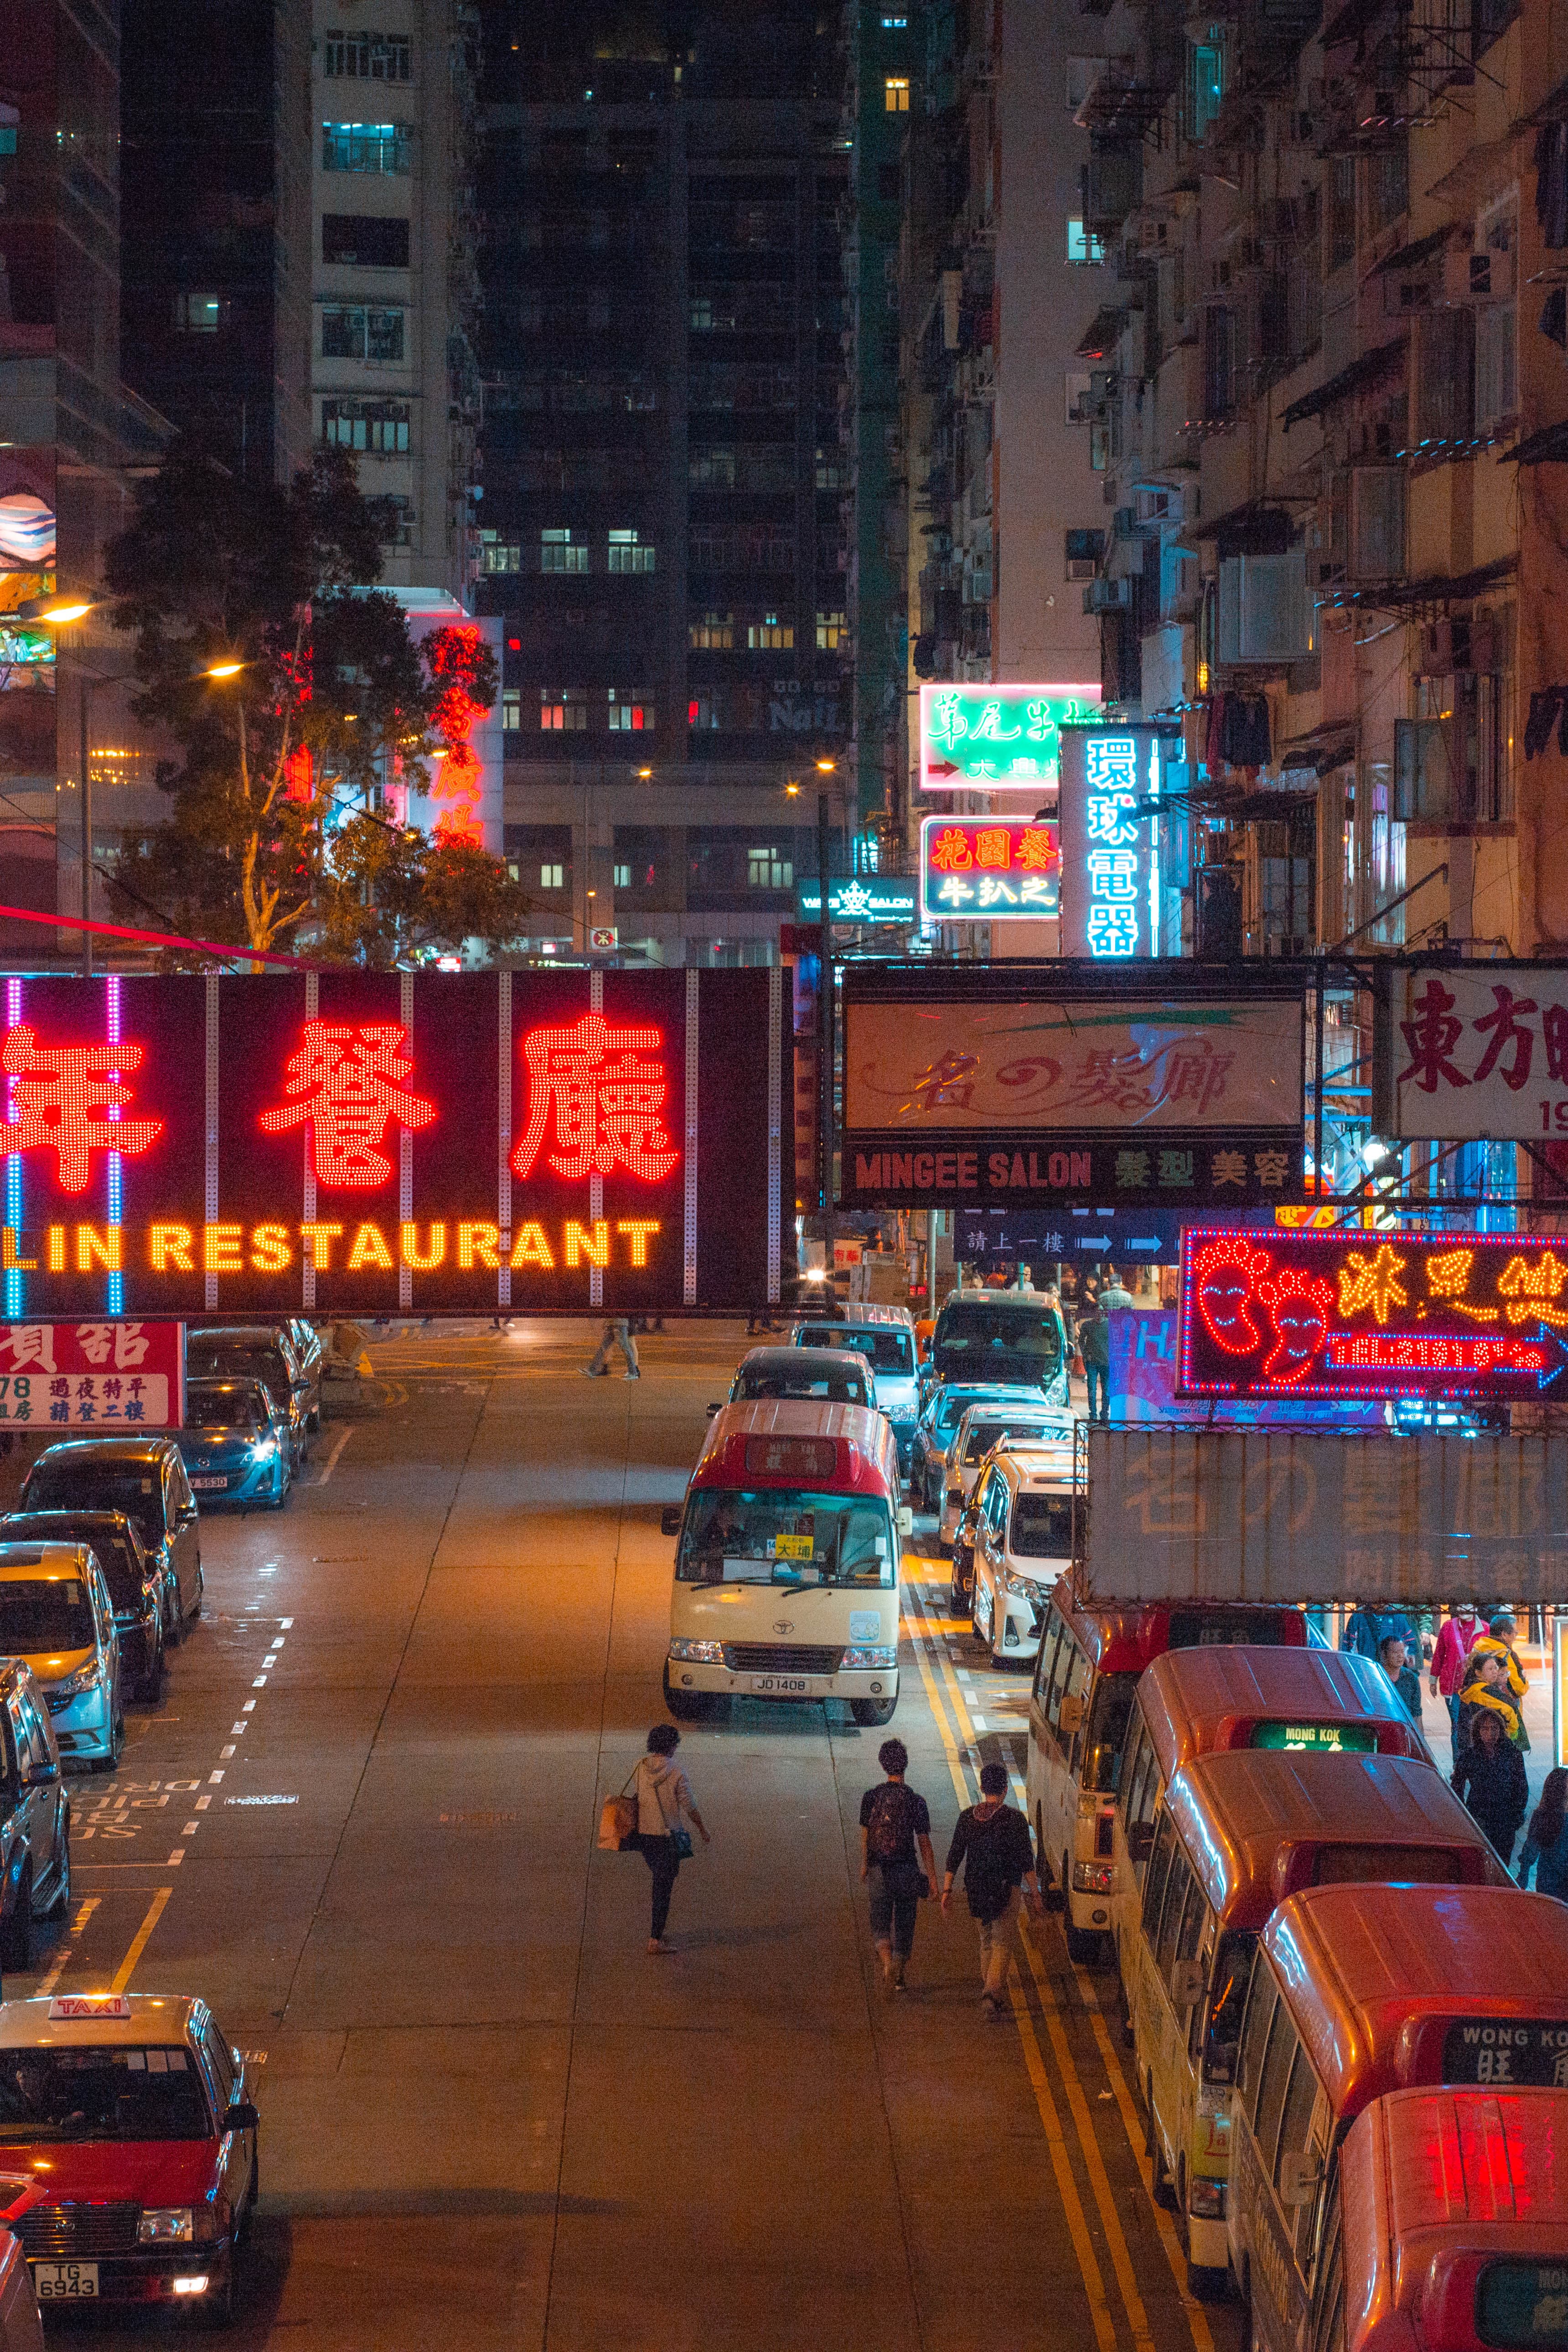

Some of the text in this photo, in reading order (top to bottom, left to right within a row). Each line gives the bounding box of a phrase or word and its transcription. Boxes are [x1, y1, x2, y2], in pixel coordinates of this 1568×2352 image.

[931, 828, 1056, 870] 花園餐
[1087, 738, 1139, 956] 環球電器
[938, 876, 1056, 907] 牛扒之
[868, 898, 913, 909] SALON
[855, 1153, 978, 1187] MINGEE
[989, 1151, 1091, 1187] SALON
[1211, 1149, 1289, 1186] 美容
[150, 1221, 660, 1271] RESTAURANT
[967, 1231, 1066, 1253] 請上一樓
[49, 1377, 147, 1400] 過夜特平
[49, 1400, 146, 1422] 請登二樓
[778, 1544, 811, 1558] 大埔
[757, 1680, 805, 1690] JD 1408
[1286, 1727, 1340, 1742] MONG KOK
[57, 1999, 122, 2016] TAXI
[53, 2264, 80, 2280] TG
[40, 2279, 94, 2296] 6943
